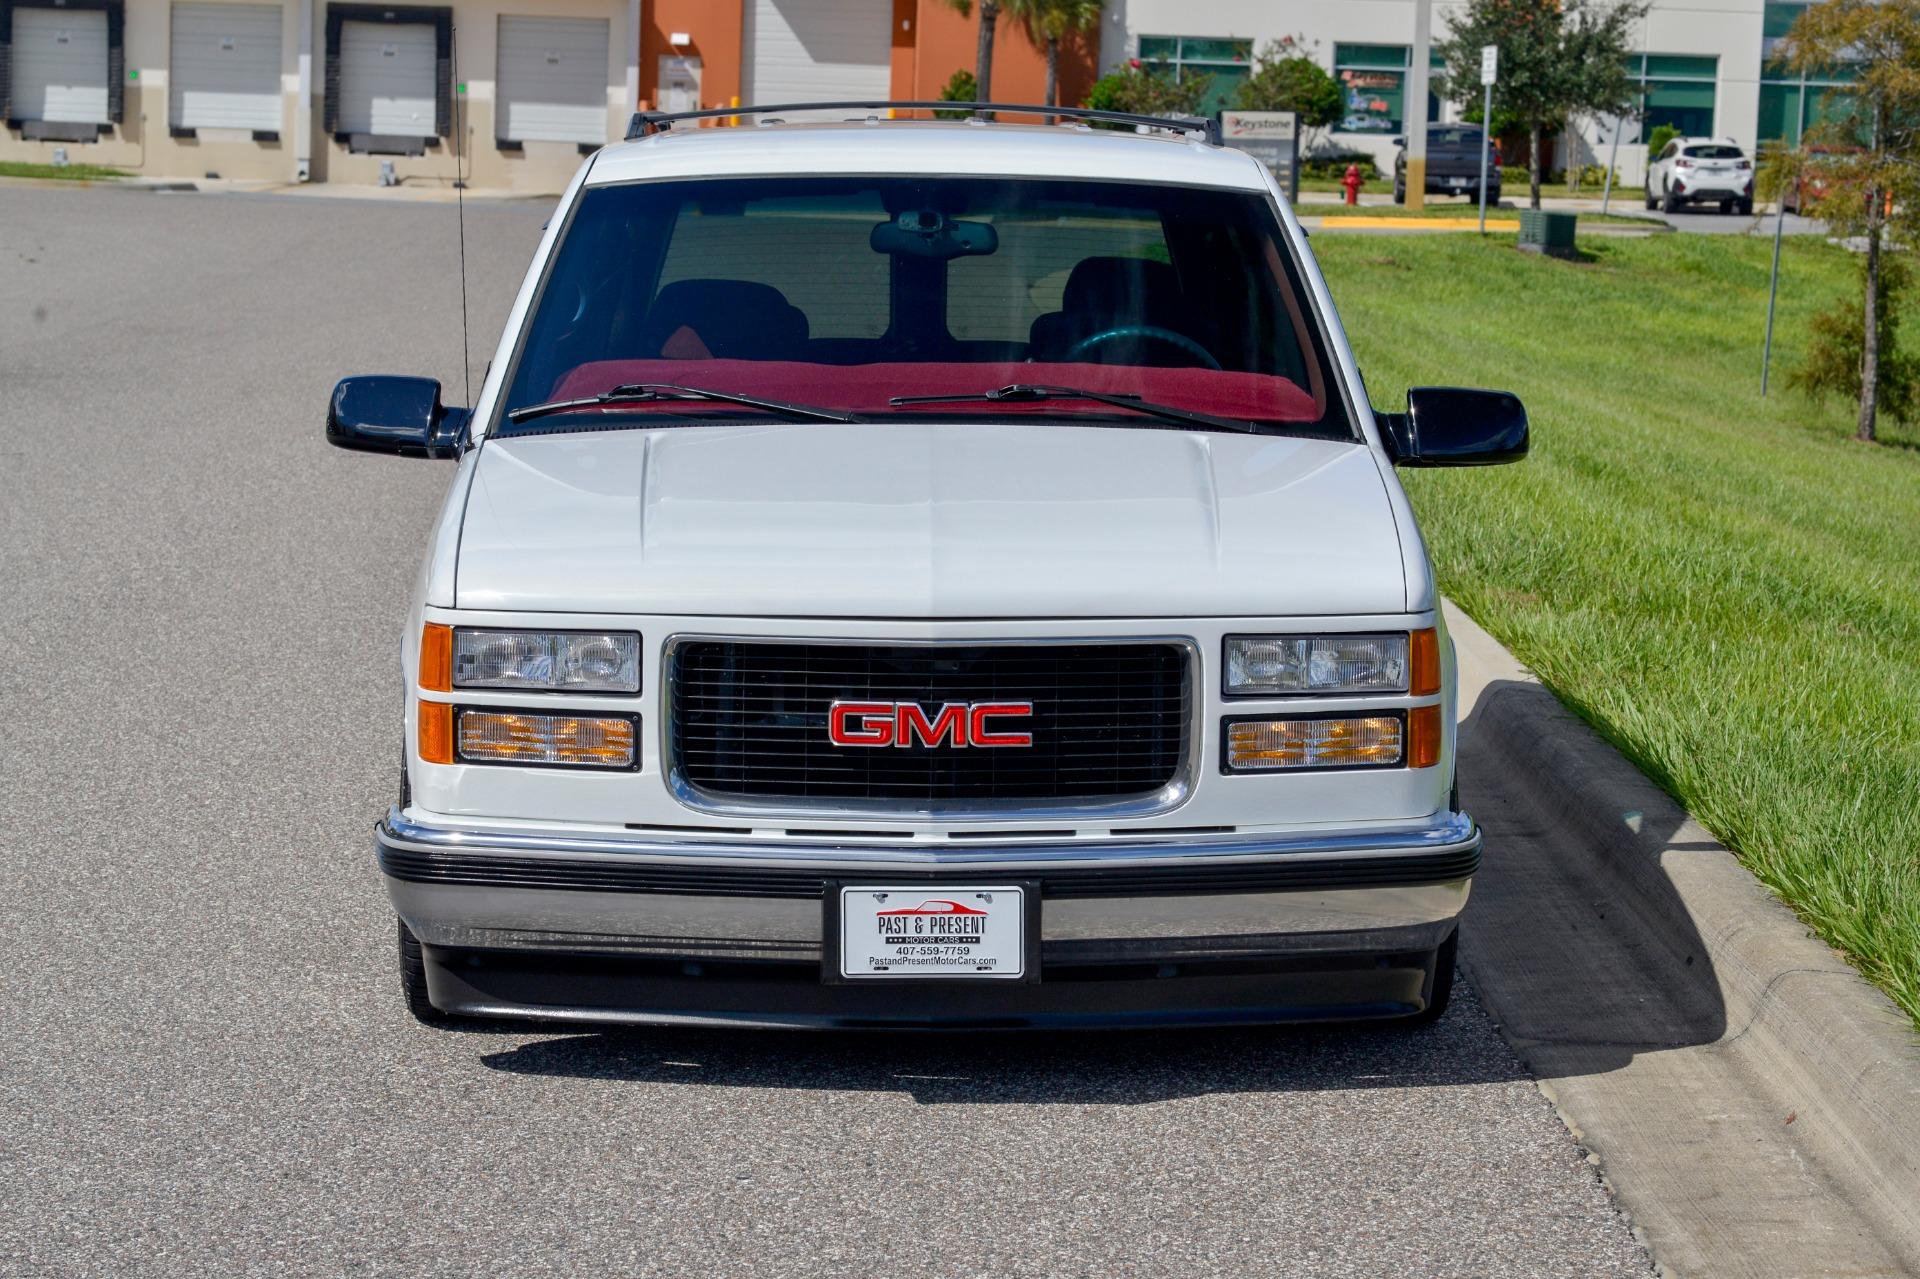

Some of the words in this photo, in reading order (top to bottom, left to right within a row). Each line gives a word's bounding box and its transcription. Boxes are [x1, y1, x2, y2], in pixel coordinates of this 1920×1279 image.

[1235, 118, 1291, 130] Keystone
[828, 701, 1033, 748] GMC
[878, 916, 908, 934] PAST
[914, 916, 924, 934] &
[930, 916, 987, 934] PRESENT
[905, 936, 935, 944] MOTOR
[937, 936, 960, 944] CARS
[896, 946, 970, 955] 407-559-7759
[869, 956, 997, 965] PastandPresentMotorCars.com
